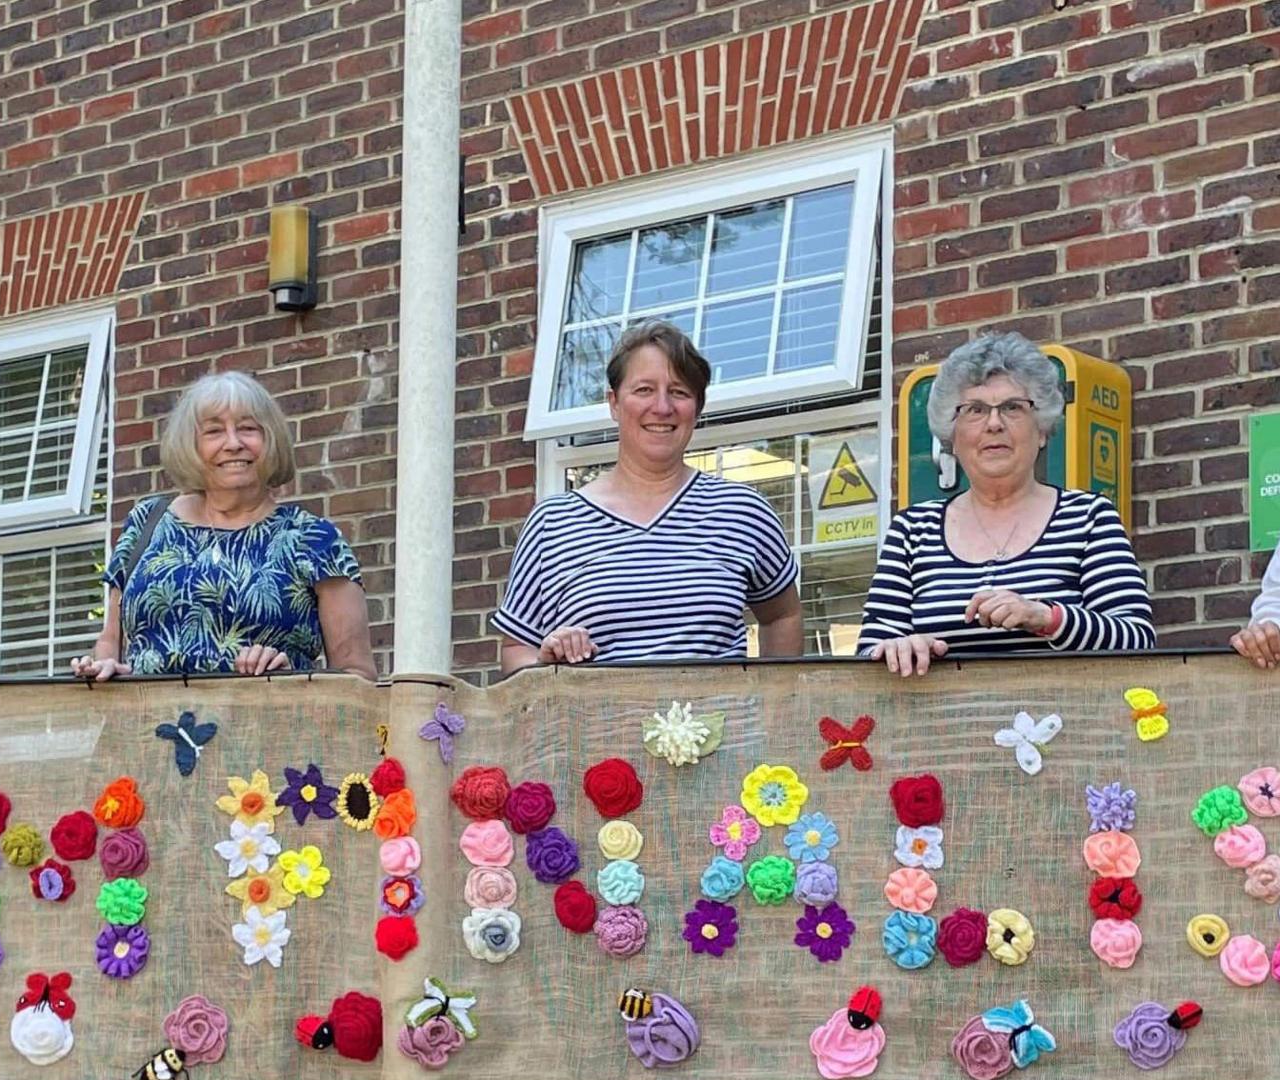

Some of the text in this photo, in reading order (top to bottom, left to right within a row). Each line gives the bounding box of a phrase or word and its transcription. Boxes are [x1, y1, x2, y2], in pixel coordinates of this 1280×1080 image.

[1091, 383, 1119, 410] AED
[825, 518, 874, 536] CCTV in
